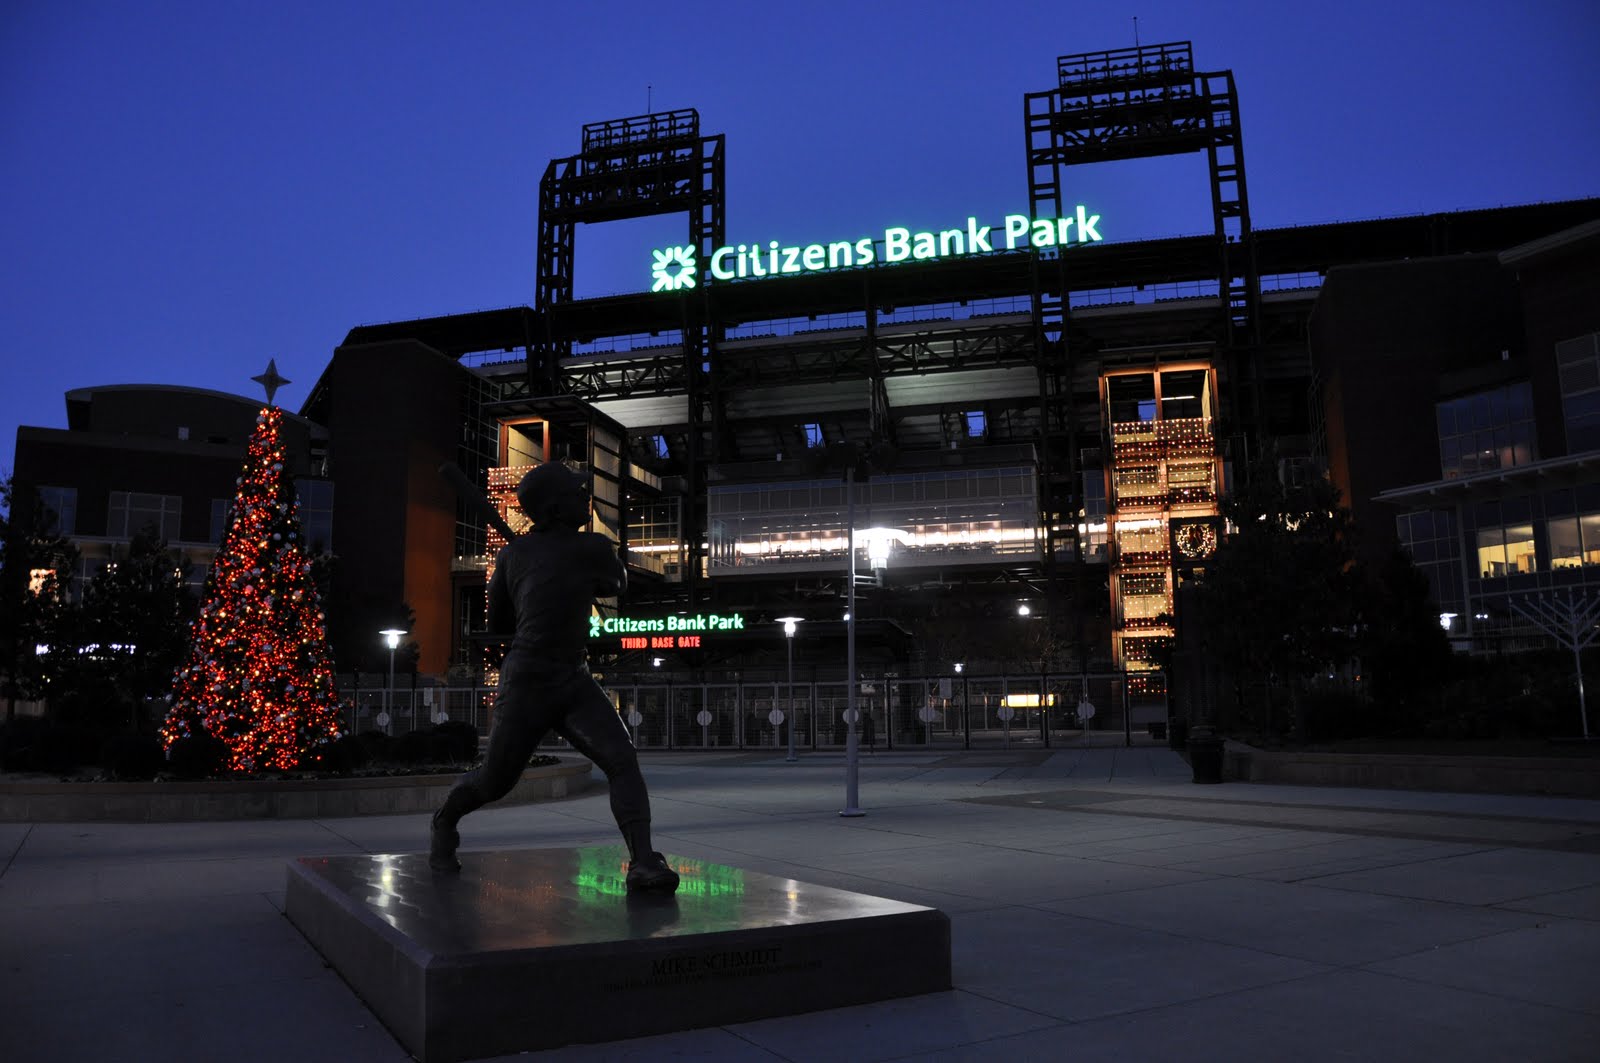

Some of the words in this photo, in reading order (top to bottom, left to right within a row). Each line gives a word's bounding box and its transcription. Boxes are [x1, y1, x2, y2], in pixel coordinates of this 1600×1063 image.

[710, 236, 874, 280] Citizens
[885, 216, 993, 263] Bank
[1004, 205, 1103, 250] Park
[603, 617, 665, 633] Citizens
[667, 614, 706, 631] Bank
[708, 613, 744, 630] Park
[621, 637, 648, 649] THIRD
[651, 637, 674, 648] BASE
[678, 636, 701, 647] GATE
[652, 956, 697, 977] MIKE
[702, 947, 782, 970] SCHMIDT
